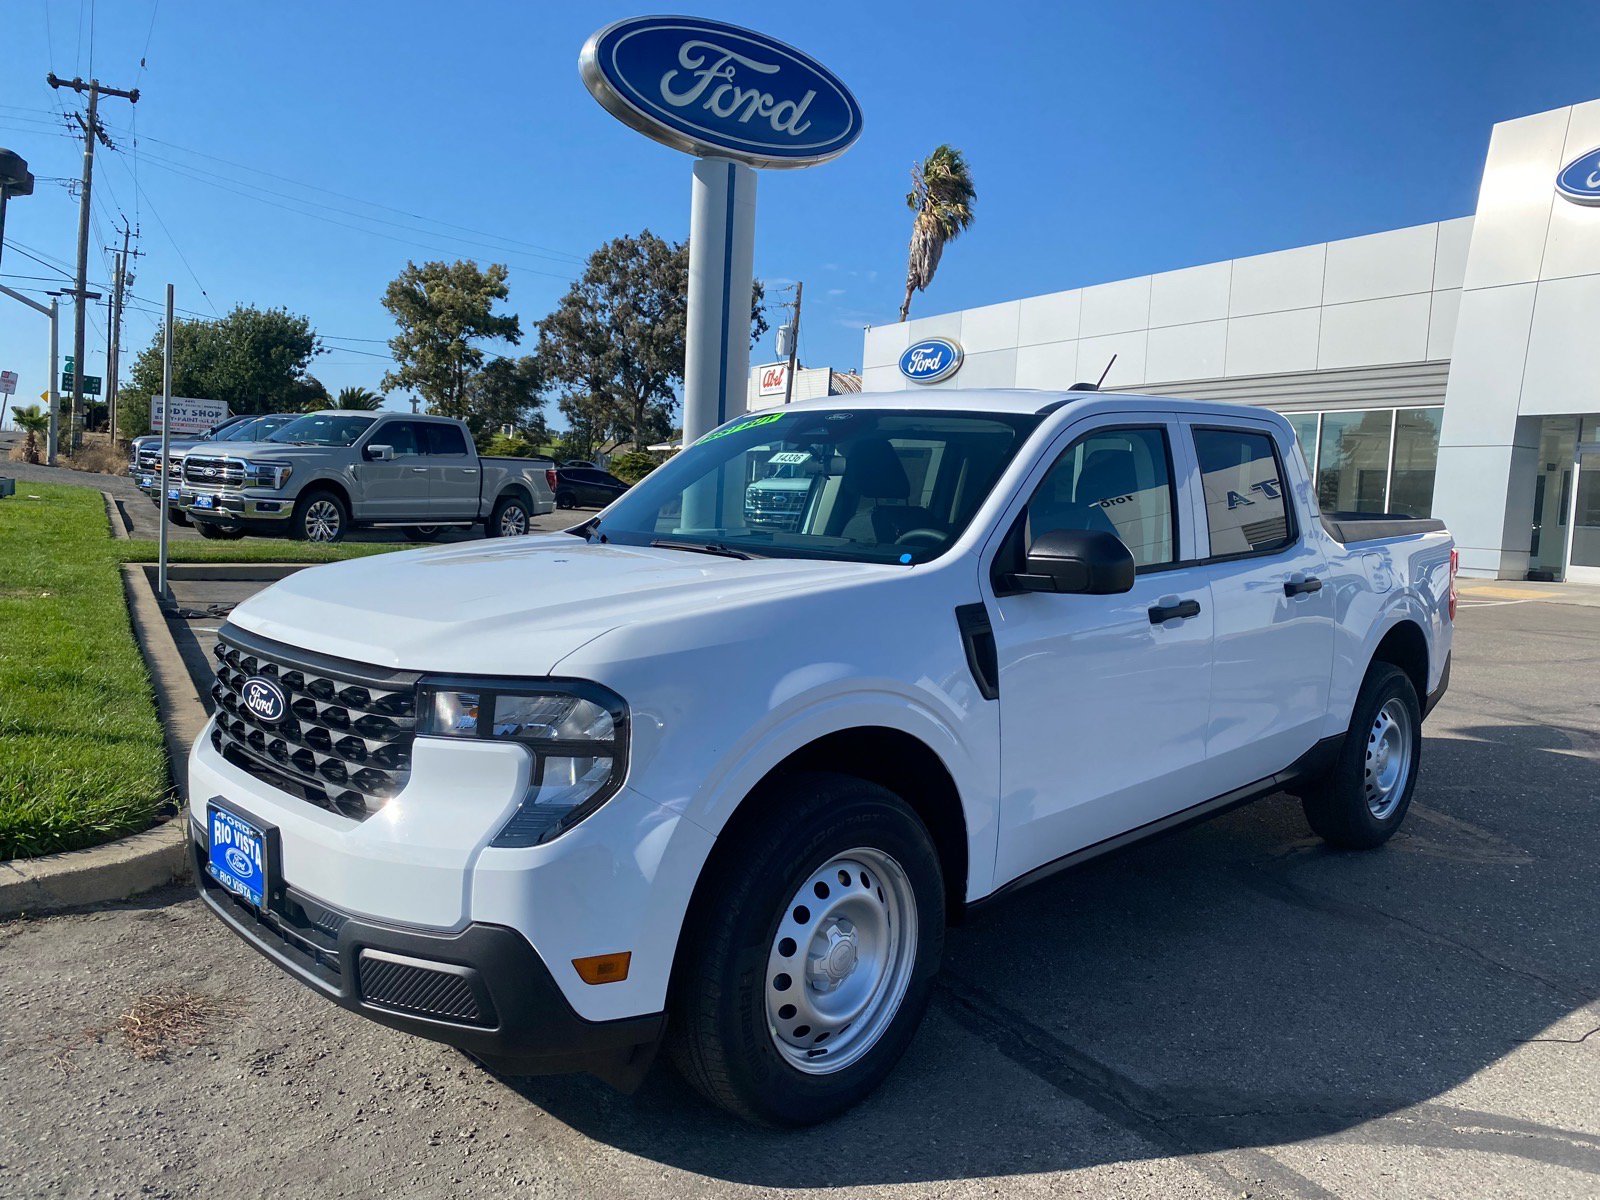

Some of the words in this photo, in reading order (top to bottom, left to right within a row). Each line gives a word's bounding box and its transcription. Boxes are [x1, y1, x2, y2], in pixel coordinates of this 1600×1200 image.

[660, 40, 816, 136] Ford
[908, 347, 943, 374] Ford
[191, 410, 222, 418] SHOP
[776, 453, 804, 463] 14336
[249, 684, 275, 715] Ford
[214, 819, 232, 847] RIO
[233, 829, 263, 874] VISTA
[232, 853, 246, 872] Ford
[219, 870, 232, 886] RIO
[232, 878, 252, 900] VISTA
